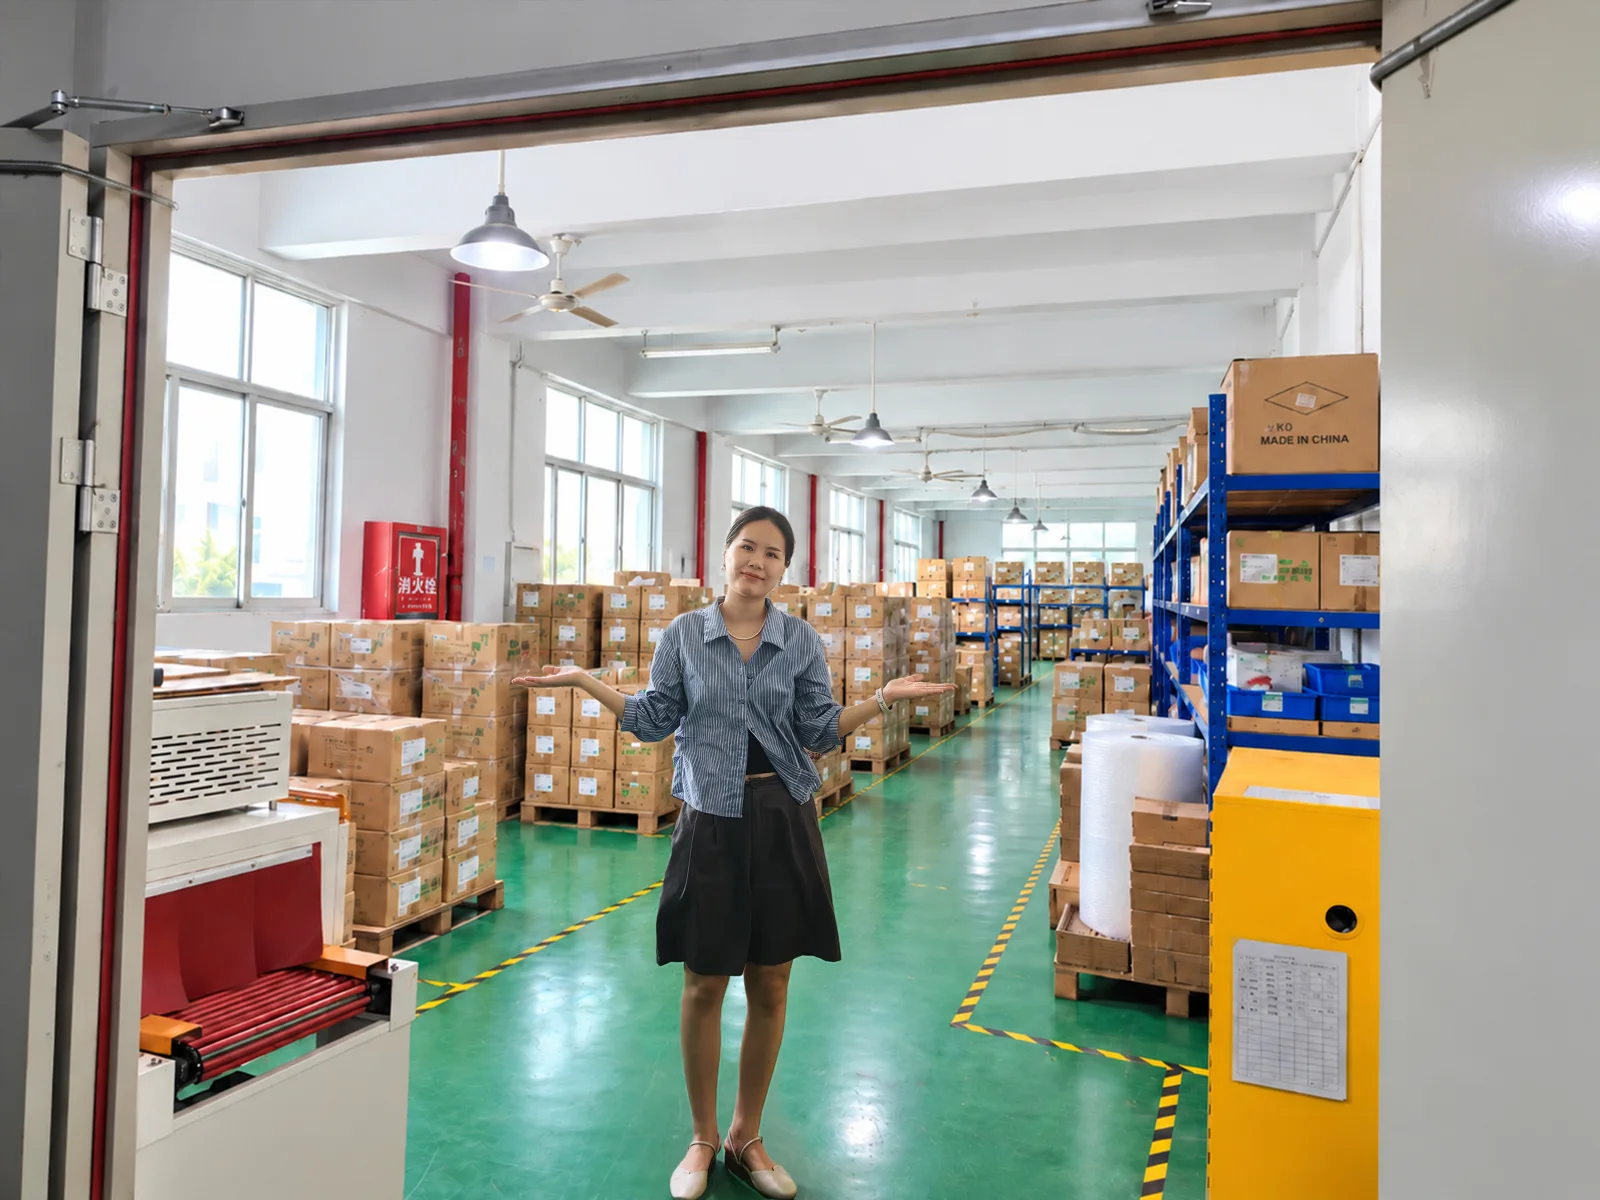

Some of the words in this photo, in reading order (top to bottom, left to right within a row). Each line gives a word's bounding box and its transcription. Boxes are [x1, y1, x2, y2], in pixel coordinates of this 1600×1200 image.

[1260, 435, 1294, 445] MADE
[1297, 435, 1309, 444] IN
[1312, 434, 1349, 444] CHINA
[398, 577, 437, 594] 消火栓
